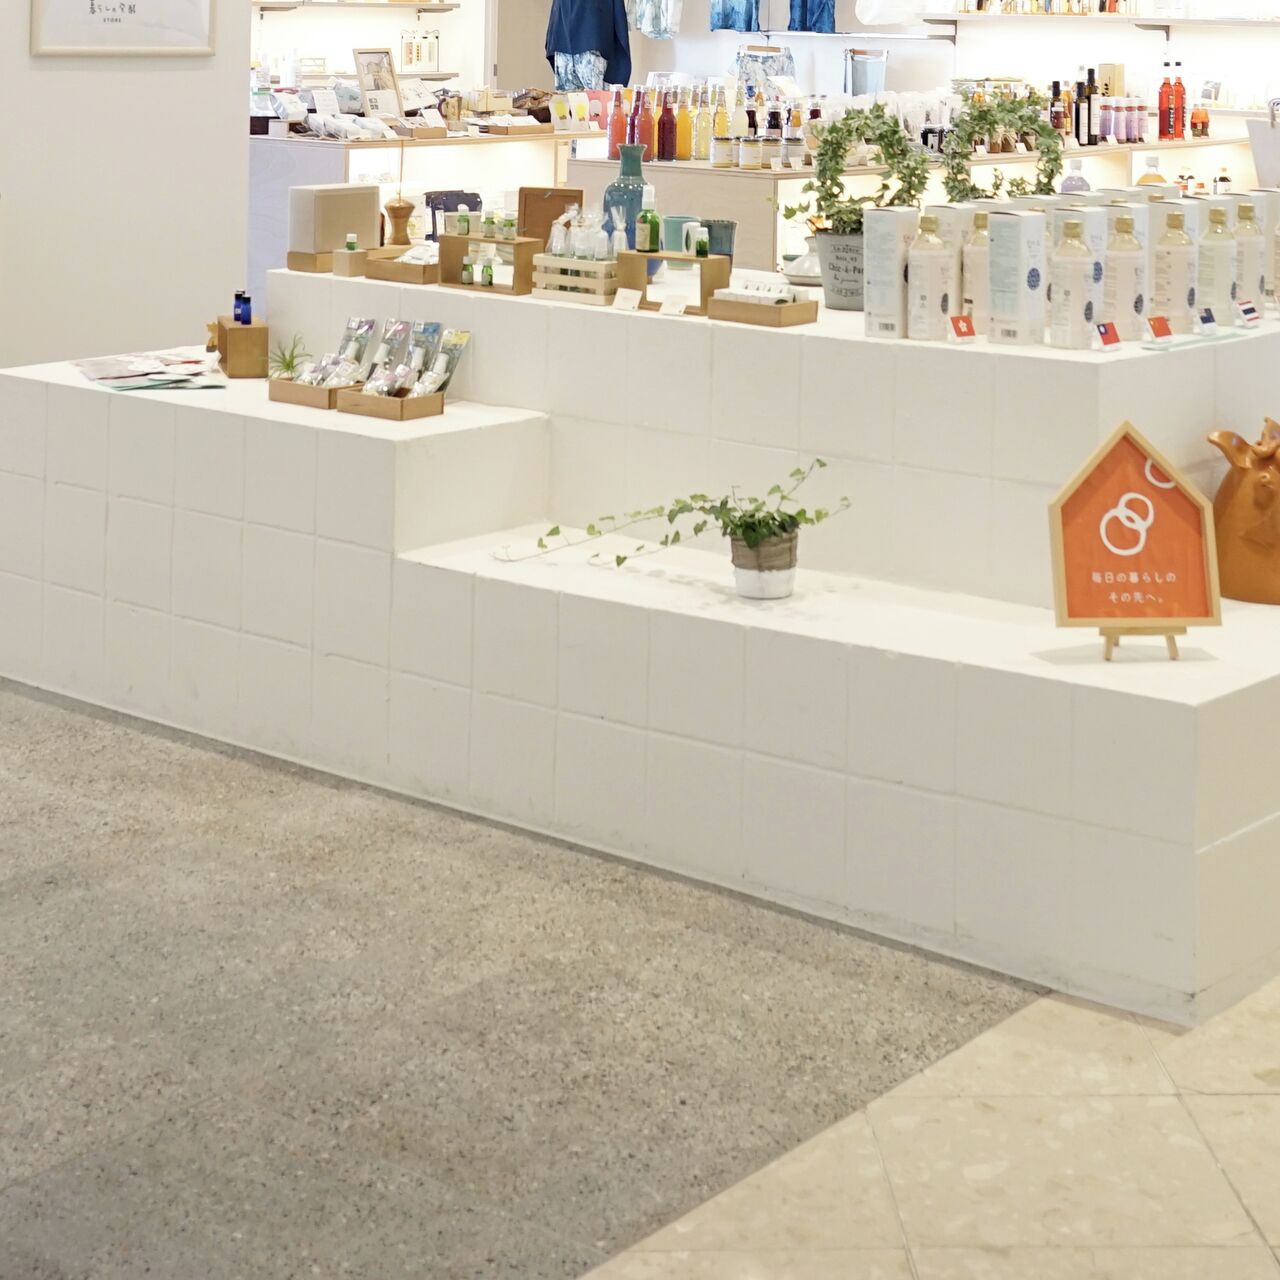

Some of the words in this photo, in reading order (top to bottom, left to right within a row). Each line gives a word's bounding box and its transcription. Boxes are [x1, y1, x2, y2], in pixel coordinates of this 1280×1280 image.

[1092, 571, 1177, 584] 毎日の暮らしの
[1108, 592, 1164, 604] その先へ。
